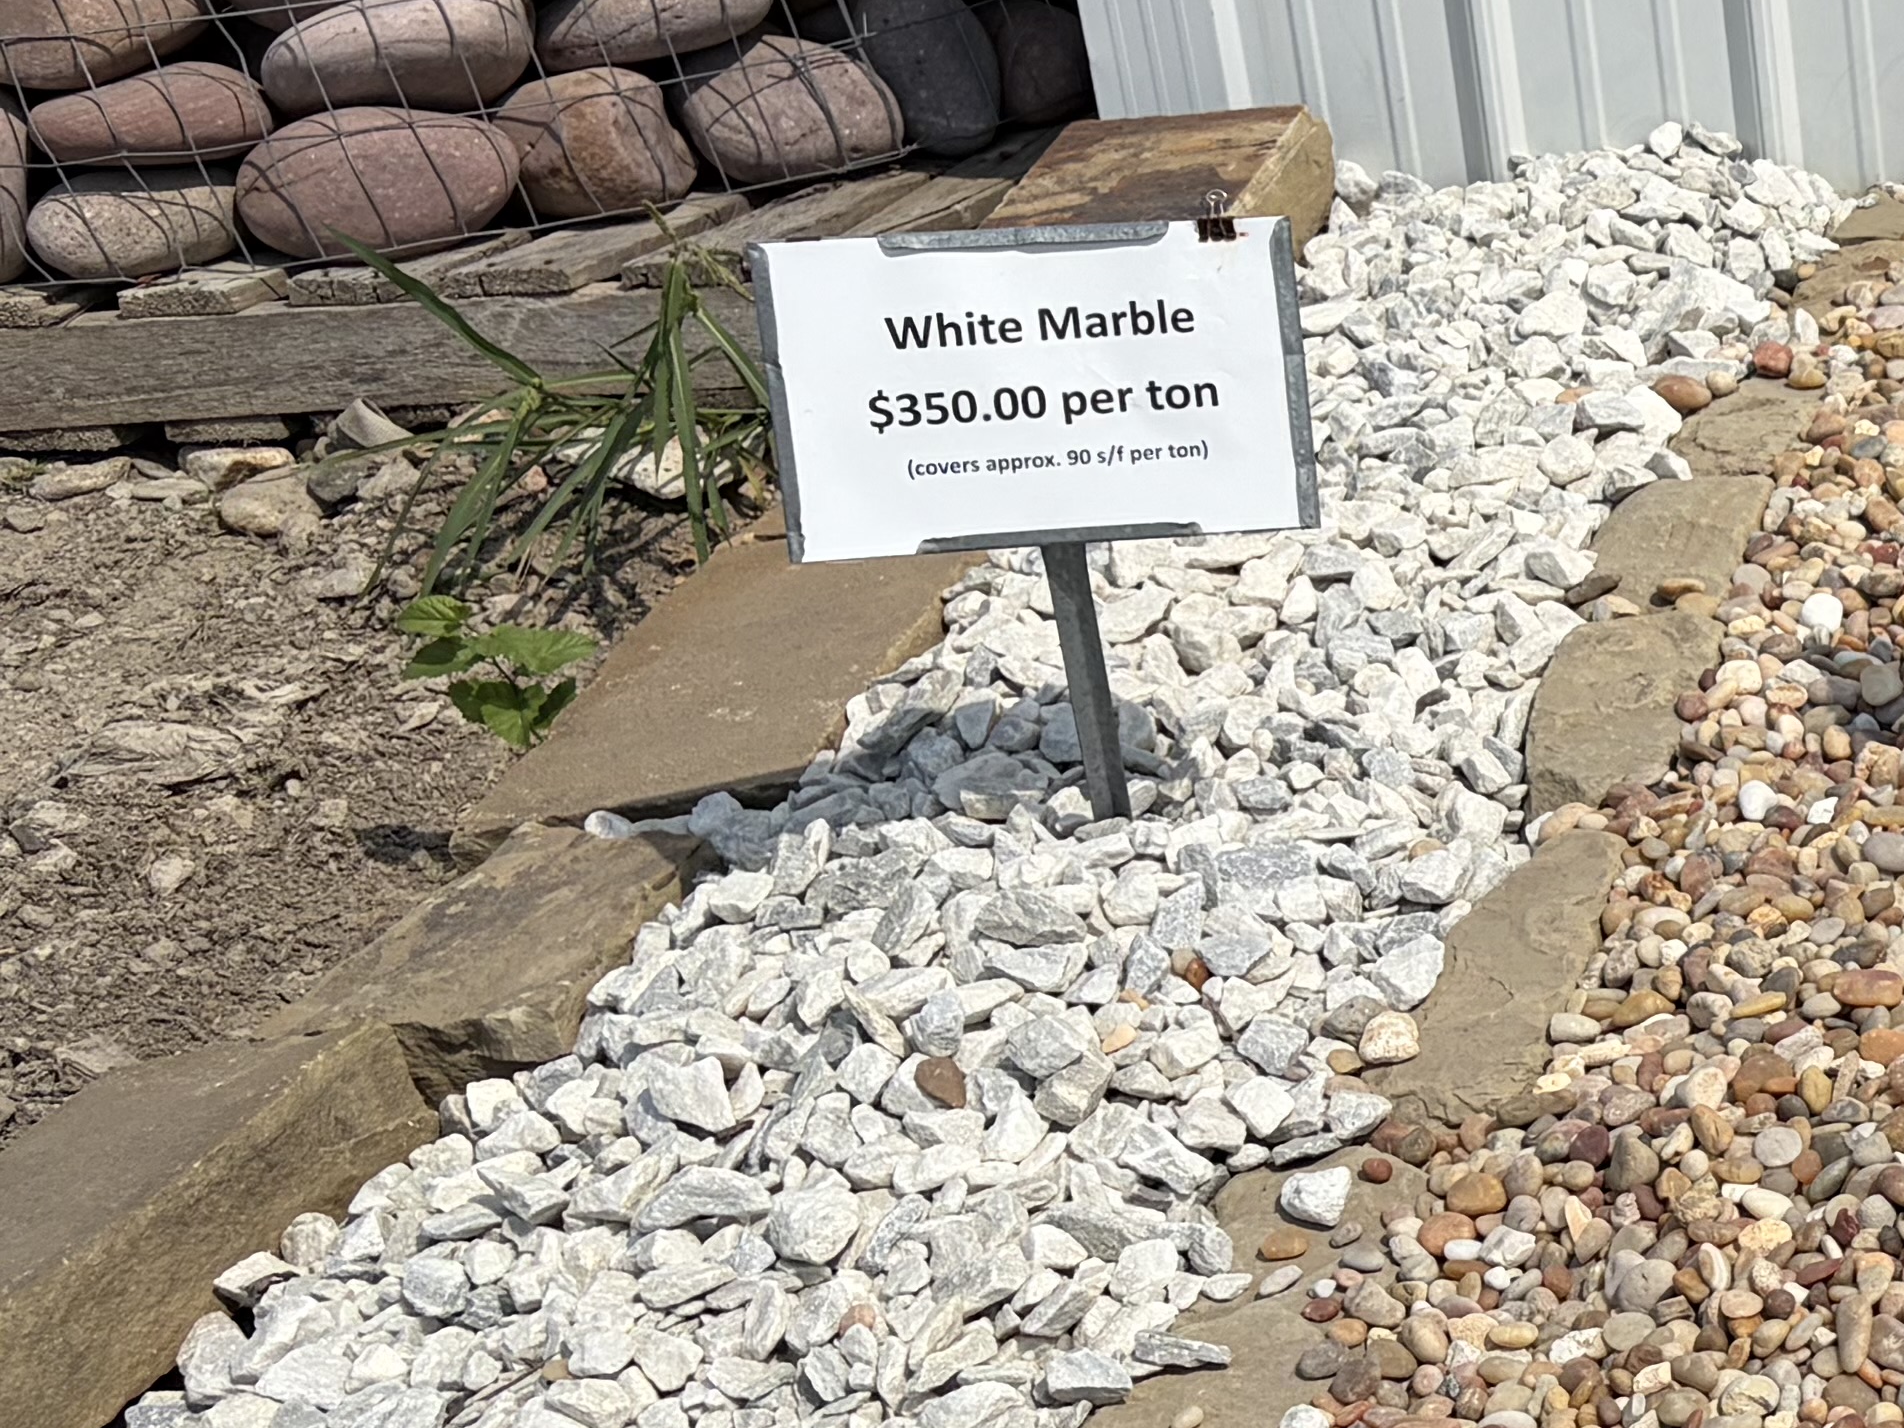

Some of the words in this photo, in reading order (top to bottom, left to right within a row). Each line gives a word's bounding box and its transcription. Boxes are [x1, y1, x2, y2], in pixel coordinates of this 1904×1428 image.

[884, 311, 1022, 350] White
[1038, 299, 1194, 341] Marble
[869, 385, 1046, 434] $350.00
[1062, 387, 1133, 425] per
[1145, 380, 1219, 410] ton
[908, 459, 980, 480] (covers
[986, 455, 1061, 474] approx.
[1067, 449, 1091, 466] 90
[1097, 445, 1124, 466] s/f
[1130, 448, 1162, 465] per
[1168, 440, 1208, 460] ton)
